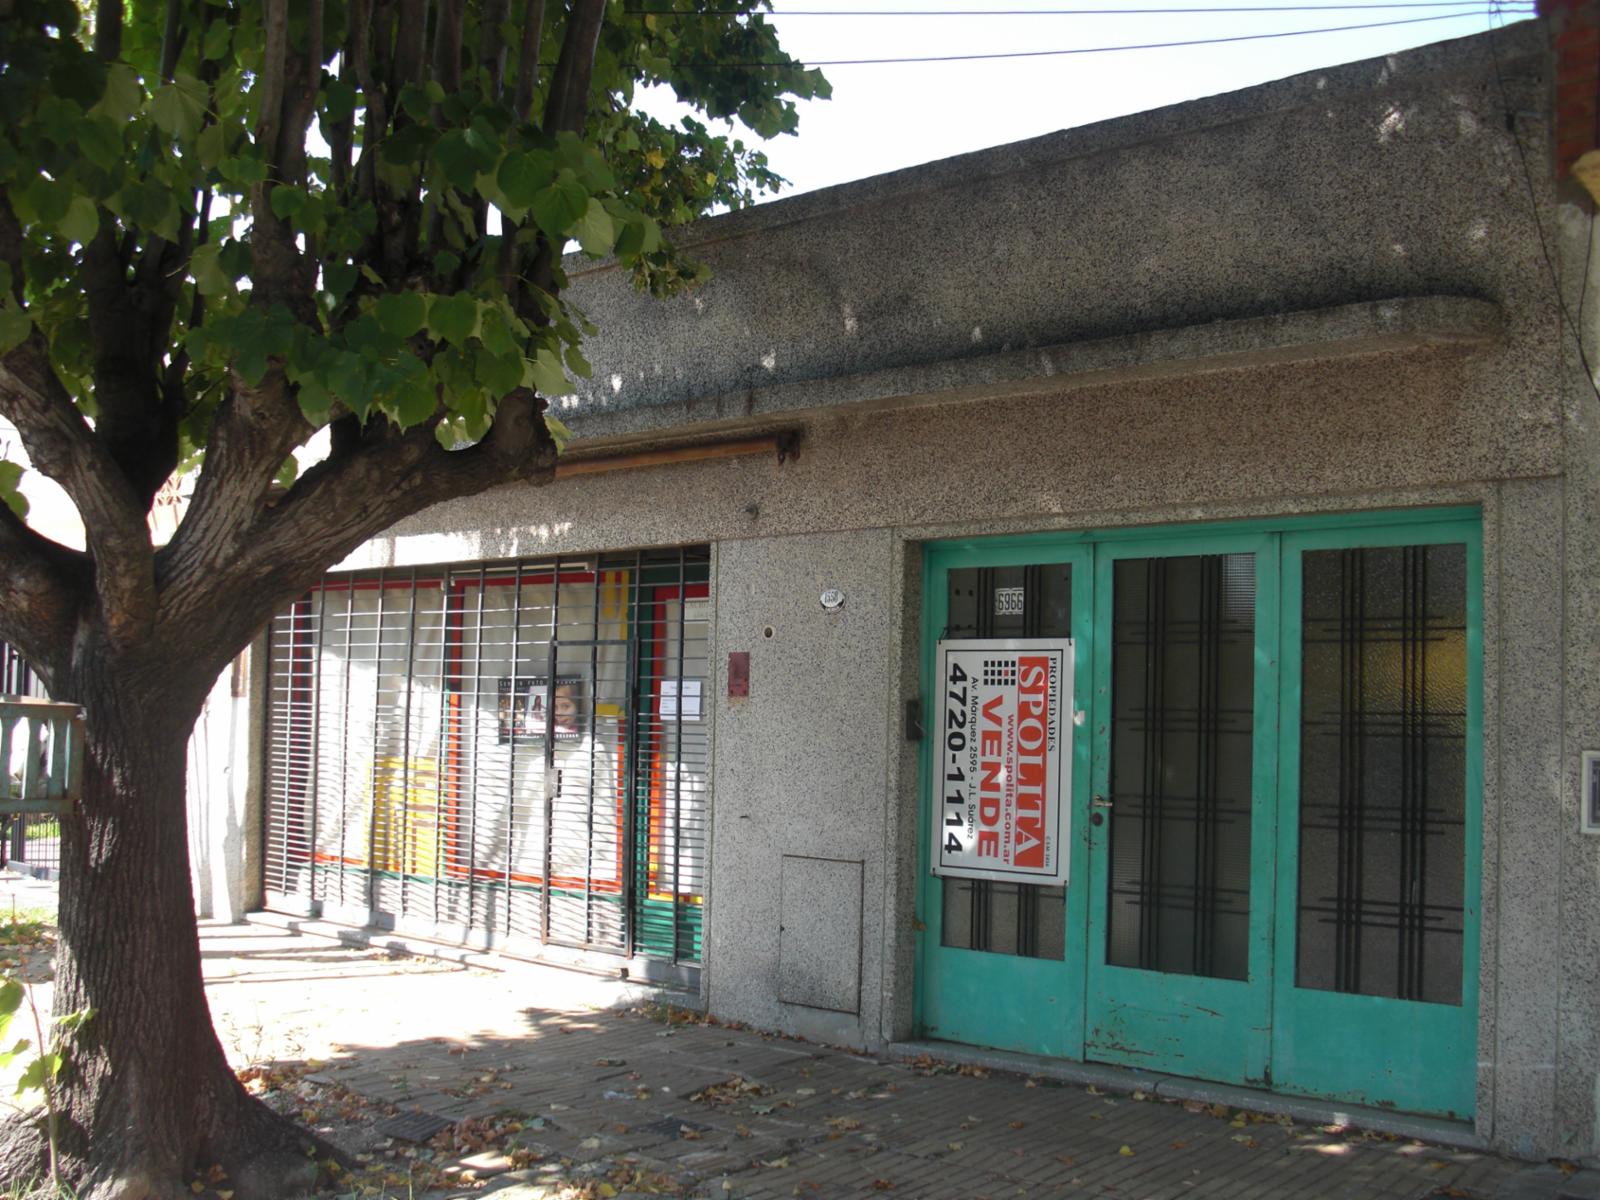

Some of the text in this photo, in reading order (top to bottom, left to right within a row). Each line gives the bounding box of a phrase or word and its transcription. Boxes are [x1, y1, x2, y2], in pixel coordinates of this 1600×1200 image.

[998, 592, 1023, 611] 6966
[968, 695, 979, 742] Márquez
[970, 676, 979, 692] Av.
[1047, 657, 1058, 752] PROPIEDADES
[944, 662, 968, 855] 4720-1114
[969, 746, 978, 772] 2595
[977, 694, 1003, 858] VENDE
[1003, 713, 1016, 865] www.spolita.com.ar
[1015, 664, 1046, 856] SPOLITA
[967, 803, 977, 840] Suárez
